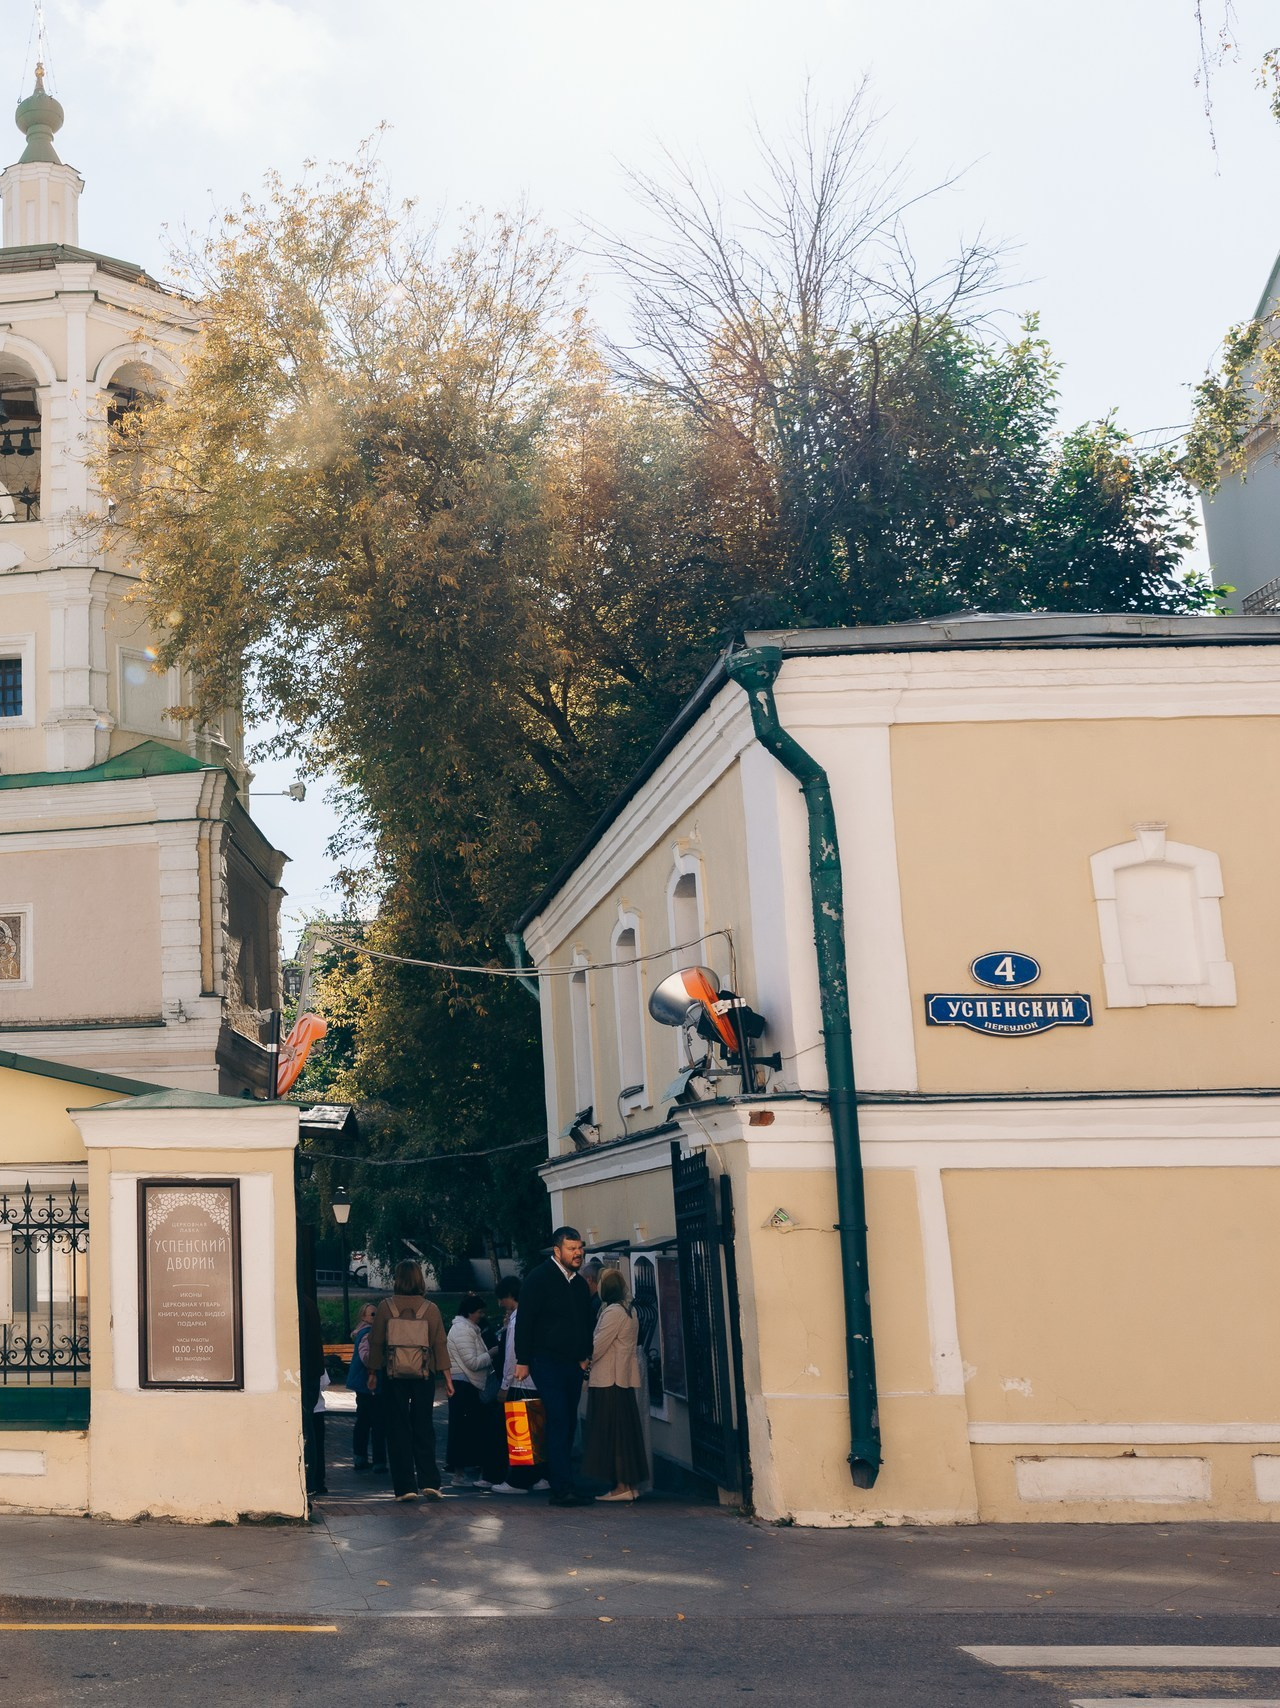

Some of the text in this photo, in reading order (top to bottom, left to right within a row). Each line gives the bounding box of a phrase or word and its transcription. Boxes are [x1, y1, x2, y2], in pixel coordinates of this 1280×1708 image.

[994, 956, 1015, 982] 4
[946, 998, 1074, 1018] УСПЕНСКИЙ
[984, 1021, 1038, 1032] ПЕРЕУЛОК
[154, 1237, 226, 1253] УСПЕНСКИЙ
[166, 1256, 215, 1272] ДВОРИК
[172, 1345, 191, 1353] 10.00
